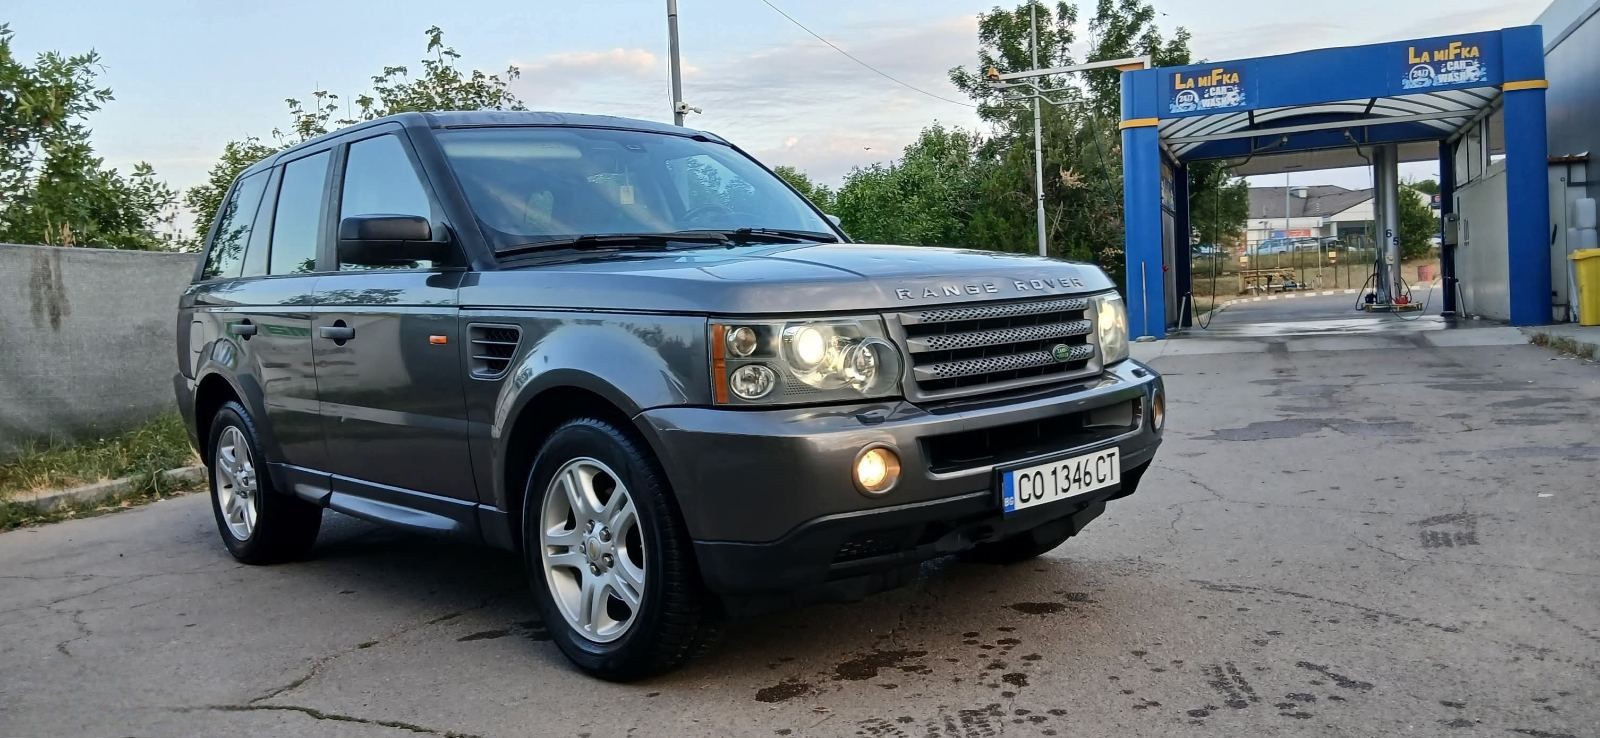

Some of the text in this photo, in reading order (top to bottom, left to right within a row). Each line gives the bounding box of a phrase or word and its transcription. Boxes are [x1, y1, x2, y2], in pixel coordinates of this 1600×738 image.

[1446, 60, 1467, 71] CAR
[1385, 229, 1392, 238] 6
[1392, 236, 1400, 246] 5
[895, 277, 1084, 300] RANGE ROVER
[1018, 452, 1116, 504] CO 1346 CT
[1004, 496, 1014, 507] BG
